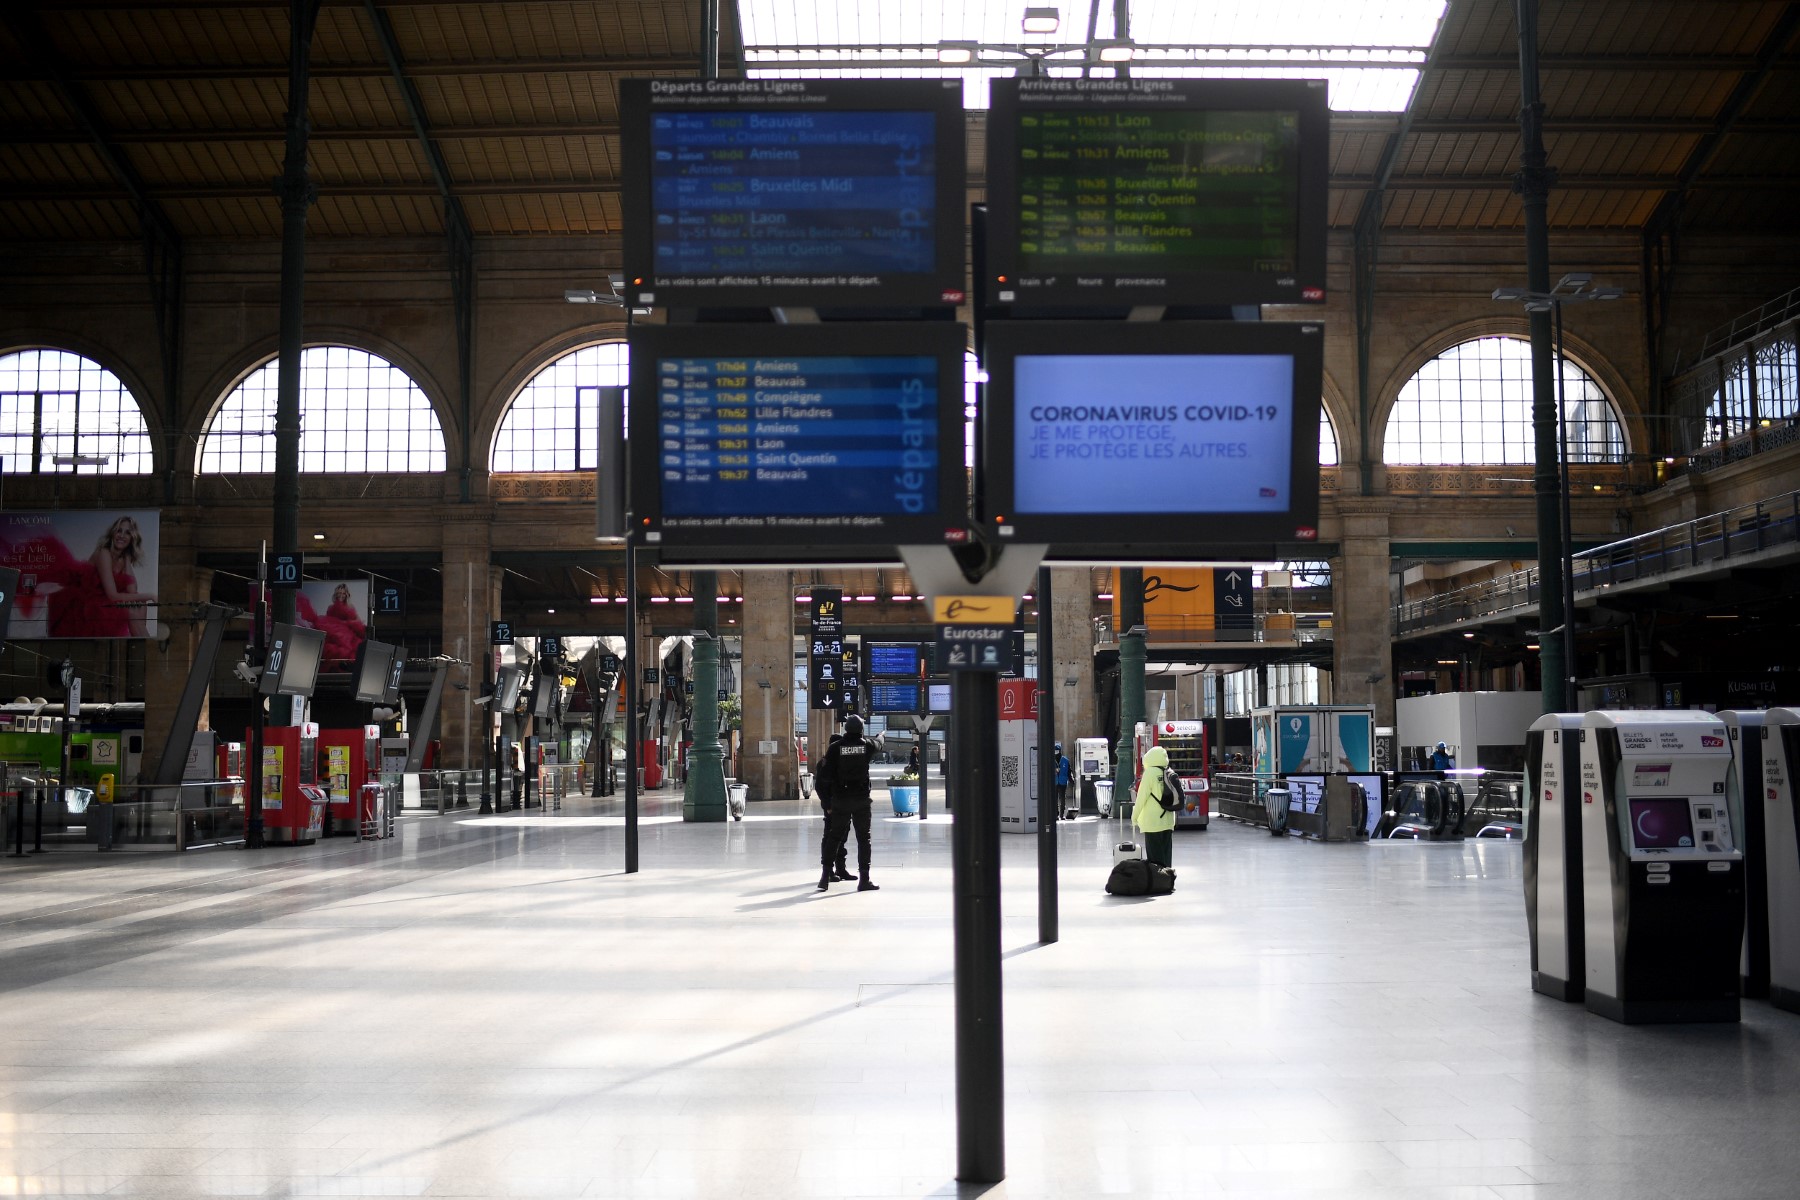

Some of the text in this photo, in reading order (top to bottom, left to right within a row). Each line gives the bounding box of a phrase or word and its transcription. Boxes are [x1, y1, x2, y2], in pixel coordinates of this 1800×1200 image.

[651, 80, 805, 93] Départs Grandes Lignes
[1018, 79, 1174, 92] Arrivées Grandes Lignes
[767, 94, 799, 103] Grandes
[1127, 93, 1159, 102] Grandes
[750, 115, 814, 128] Beauvais
[1115, 114, 1151, 127] Laon
[750, 147, 800, 159] Amiens
[1115, 145, 1169, 158] Amiens
[688, 163, 734, 175] Amiens
[750, 178, 853, 192] Bruxelles Midi
[1114, 177, 1198, 189] Bruxelles Midi
[1114, 194, 1197, 206] Saint Quentin
[751, 211, 787, 224] Laon
[1114, 209, 1167, 221] Beauvais
[1114, 225, 1193, 237] Lille Flandres
[1114, 241, 1167, 253] Beauvais
[655, 276, 669, 285] Les
[671, 277, 695, 286] voies
[696, 277, 717, 285] sont
[718, 276, 759, 285] affichées
[760, 276, 772, 285] 15
[773, 276, 810, 285] minutes
[811, 277, 836, 285] avant
[837, 276, 847, 285] le
[1019, 276, 1041, 286] train
[1077, 276, 1104, 286] heure
[1115, 277, 1167, 288] provenance
[1276, 276, 1296, 286] voie
[754, 361, 799, 372] Amiens
[754, 376, 806, 387] Beauvais
[754, 391, 823, 404] Compiègne
[755, 407, 779, 418] Lille
[781, 407, 833, 418] Flandres
[1030, 405, 1278, 421] CORONAVIRUS COVID-19
[755, 422, 800, 434] Amiens
[1030, 425, 1049, 441] JE
[1055, 425, 1081, 440] ME
[756, 438, 785, 449] Laon
[894, 378, 932, 512] départs
[1030, 443, 1049, 459] JE
[1143, 443, 1175, 458] LES
[1179, 443, 1251, 458] AUTRES.
[756, 453, 786, 465] Saint
[788, 453, 838, 466] Quentin
[756, 469, 808, 480] Beauvais
[9, 516, 53, 526] LANCÔME
[662, 517, 677, 526] Les
[679, 518, 702, 526] voies
[703, 517, 724, 526] sont
[725, 517, 764, 526] affichées
[766, 517, 777, 526] 15
[778, 517, 814, 526] minutes
[815, 517, 840, 526] avant
[842, 517, 851, 526] le
[1295, 529, 1316, 538] SNCF
[12, 544, 48, 554] La vie
[3, 553, 56, 563] est belle
[275, 564, 297, 581] 10
[381, 595, 399, 609] 11
[496, 629, 510, 640] 12
[944, 626, 1005, 640] Eurostar
[544, 643, 557, 653] 13
[813, 644, 841, 653] 20 21
[270, 650, 282, 671] 10
[603, 660, 615, 669] 14
[392, 668, 401, 686] 11
[647, 673, 657, 681] 15
[667, 678, 676, 686] 16
[1727, 680, 1777, 693] KUSMI TEA
[1661, 742, 1684, 750] échange
[1544, 779, 1558, 789] échange
[1584, 781, 1599, 791] échange
[1767, 777, 1785, 786] échange
